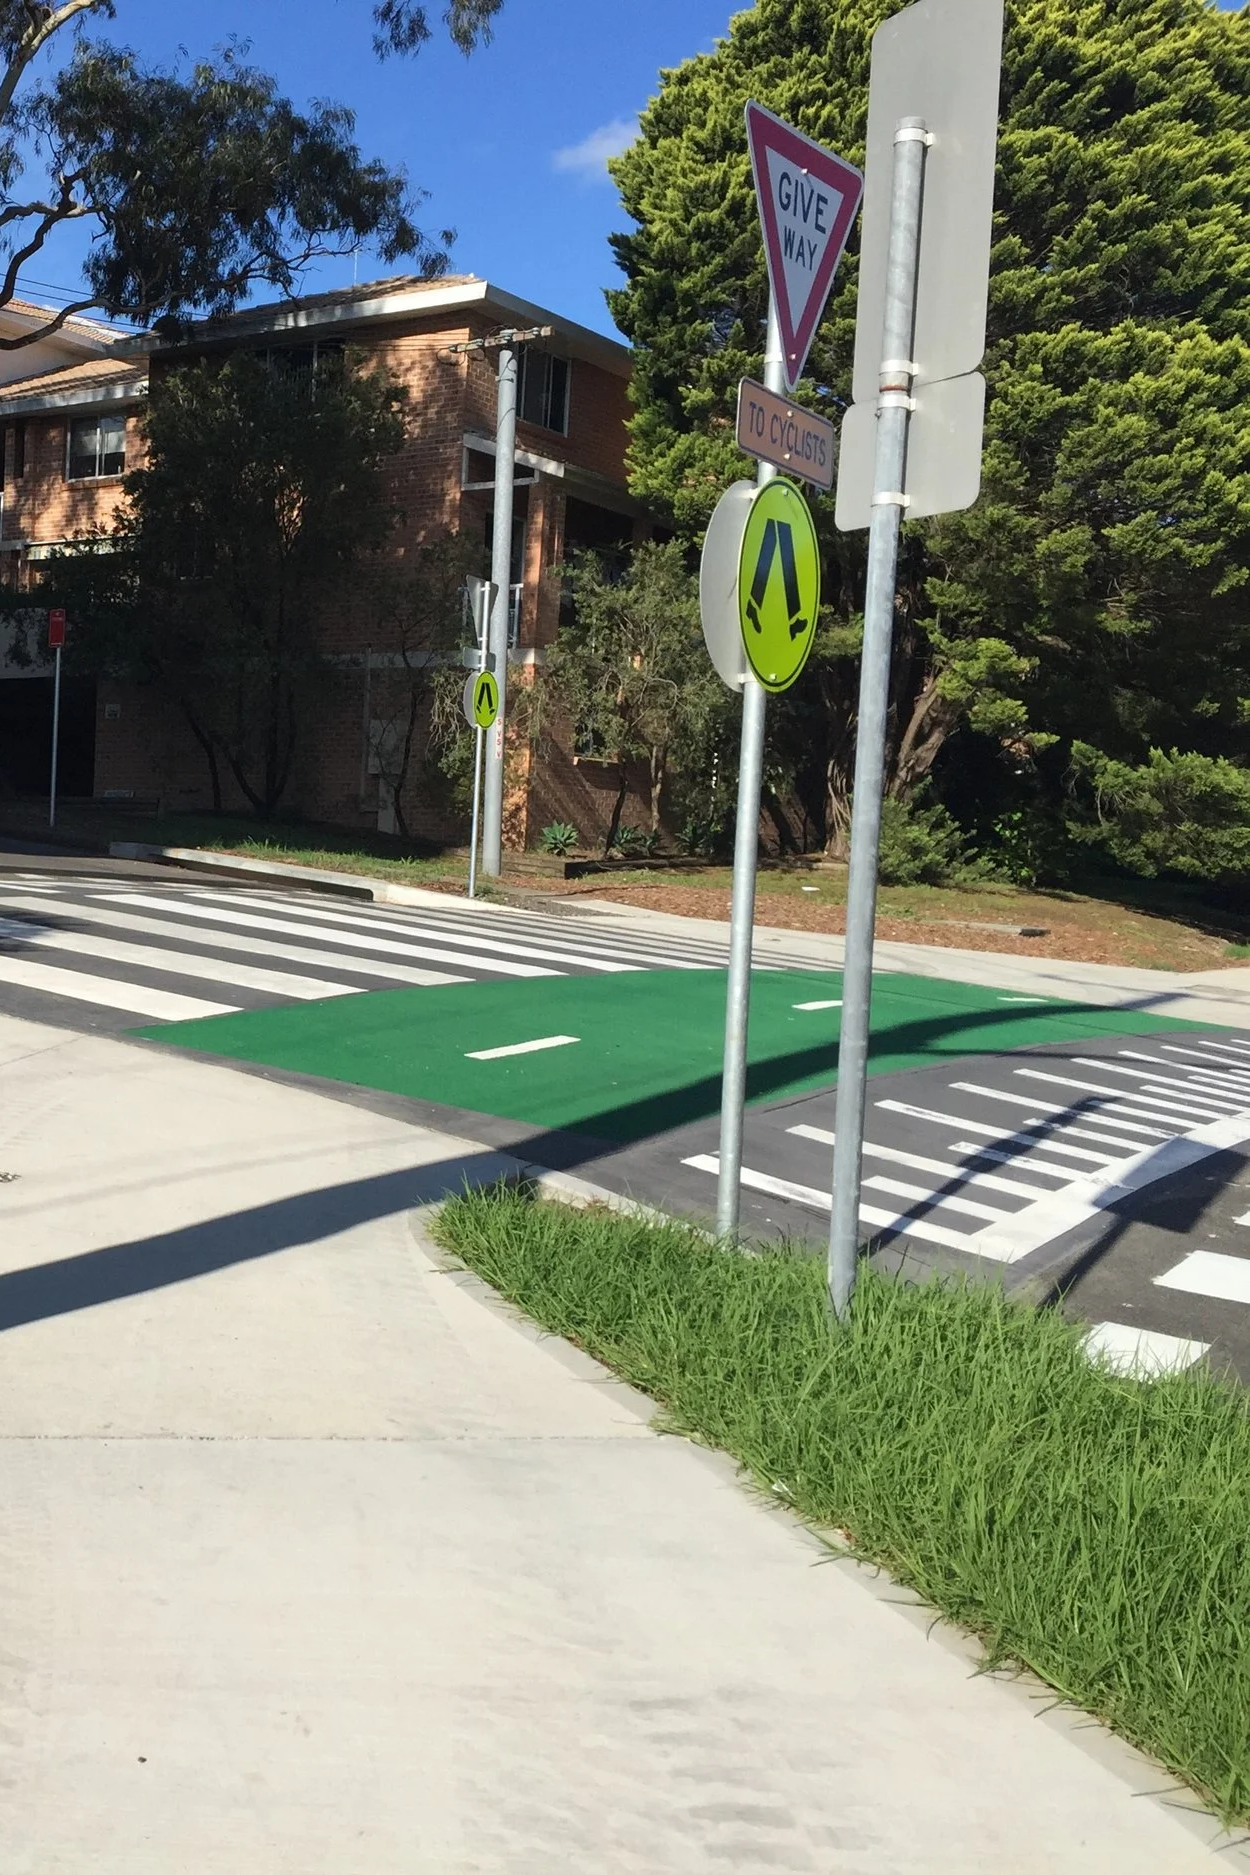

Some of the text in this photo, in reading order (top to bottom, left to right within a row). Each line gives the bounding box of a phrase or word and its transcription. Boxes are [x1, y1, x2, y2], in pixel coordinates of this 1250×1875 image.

[778, 171, 829, 234] GIVE
[784, 225, 817, 271] WAY
[749, 401, 826, 467] TO CYCLISTS
